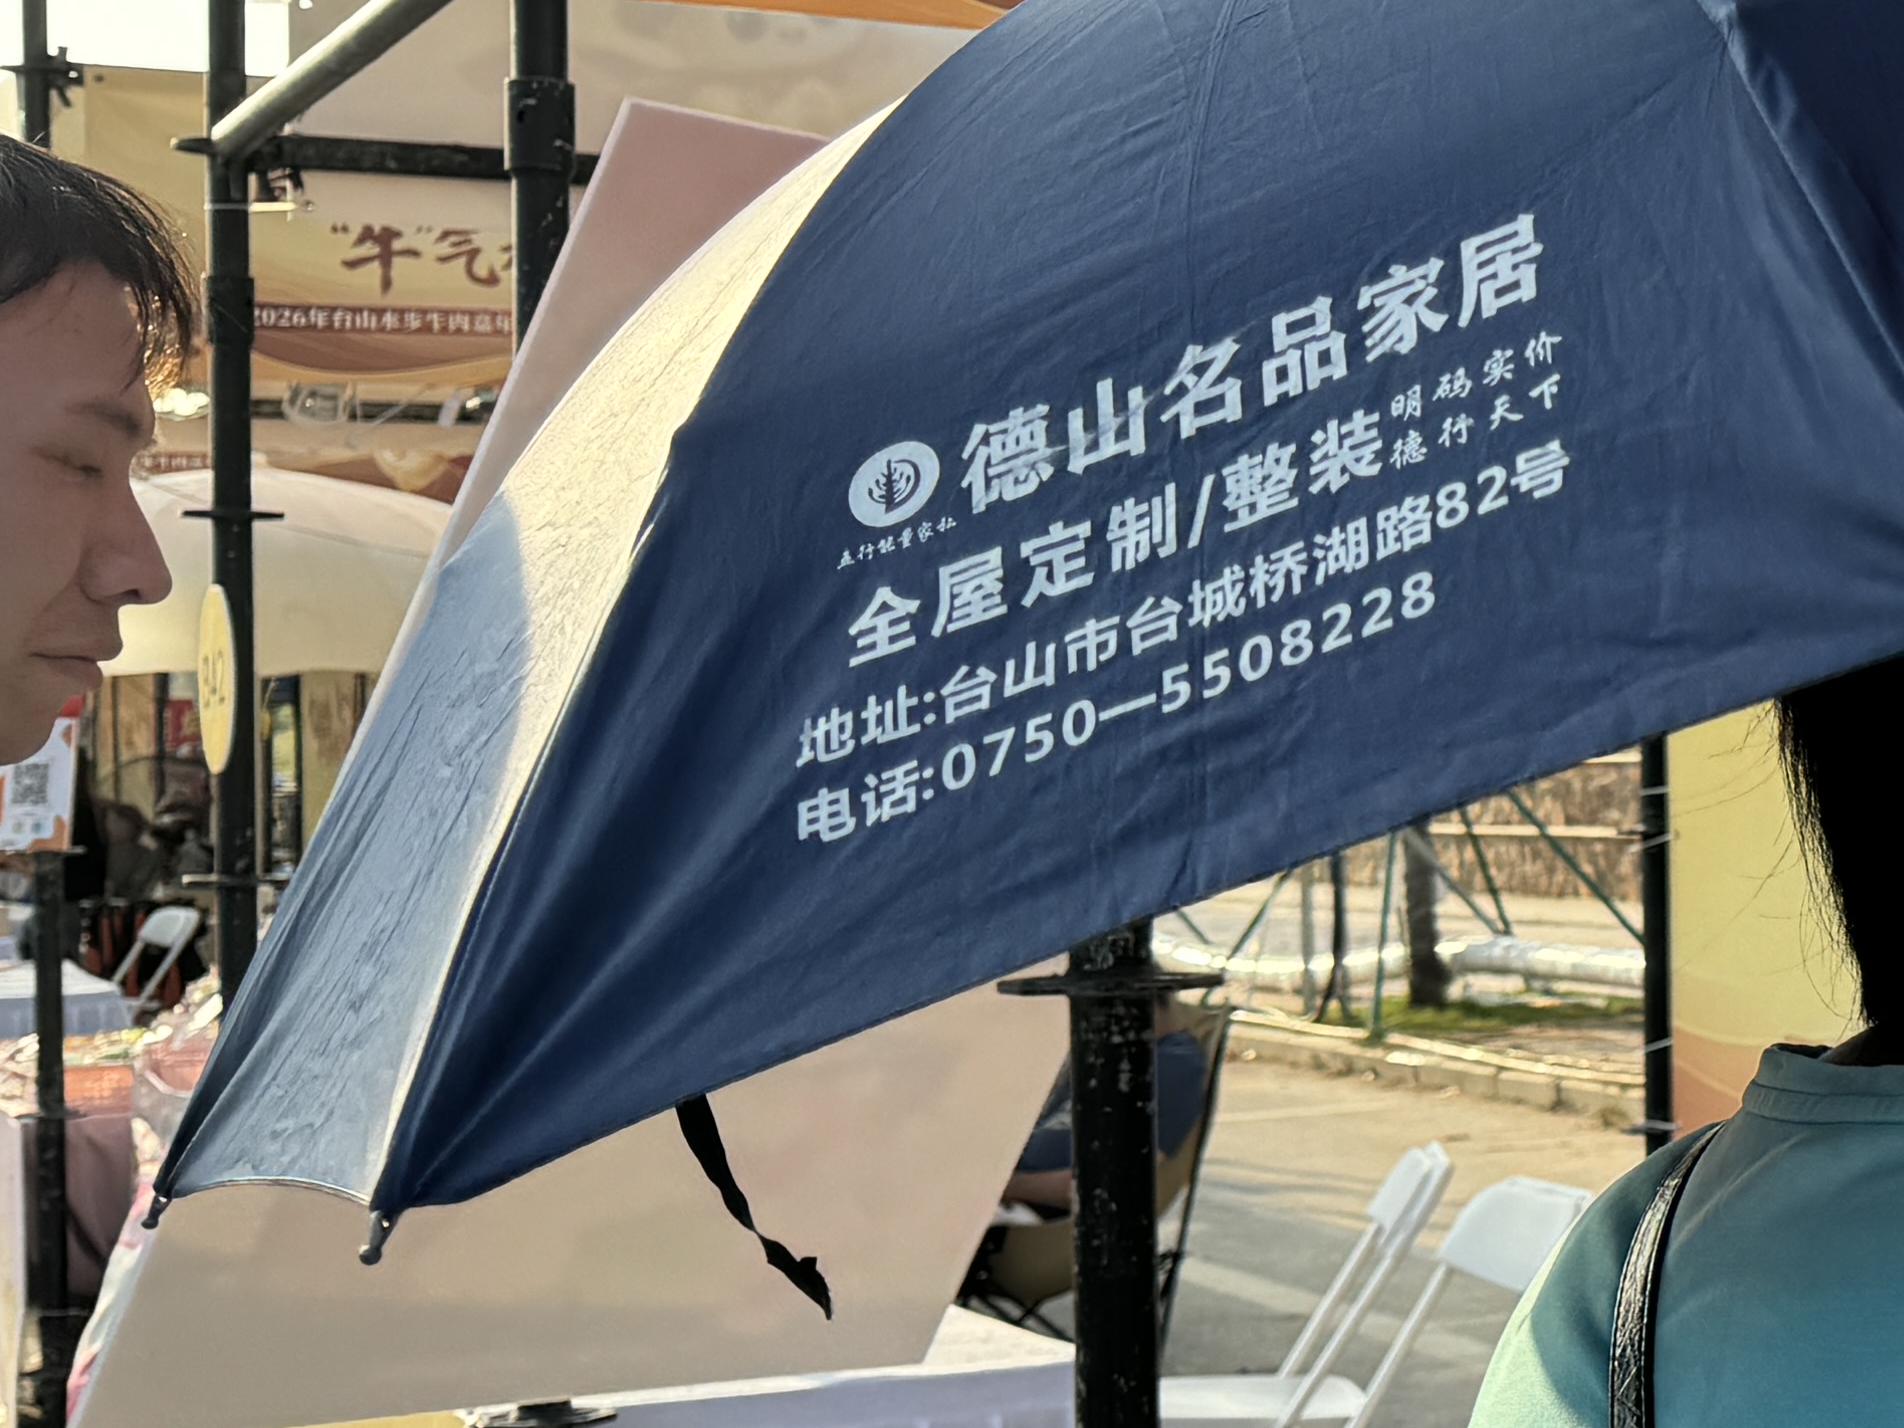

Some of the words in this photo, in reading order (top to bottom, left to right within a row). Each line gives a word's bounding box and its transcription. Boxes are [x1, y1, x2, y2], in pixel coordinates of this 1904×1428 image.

[330, 223, 513, 298] “牛”气
[958, 212, 1545, 513] 德山名品家居
[1390, 331, 1562, 421] 明码实价
[1390, 373, 1561, 469] 德行天下
[795, 437, 1571, 769] 地址:台山市台城桥湖路82号
[847, 407, 1385, 669] 全屋定制/整装
